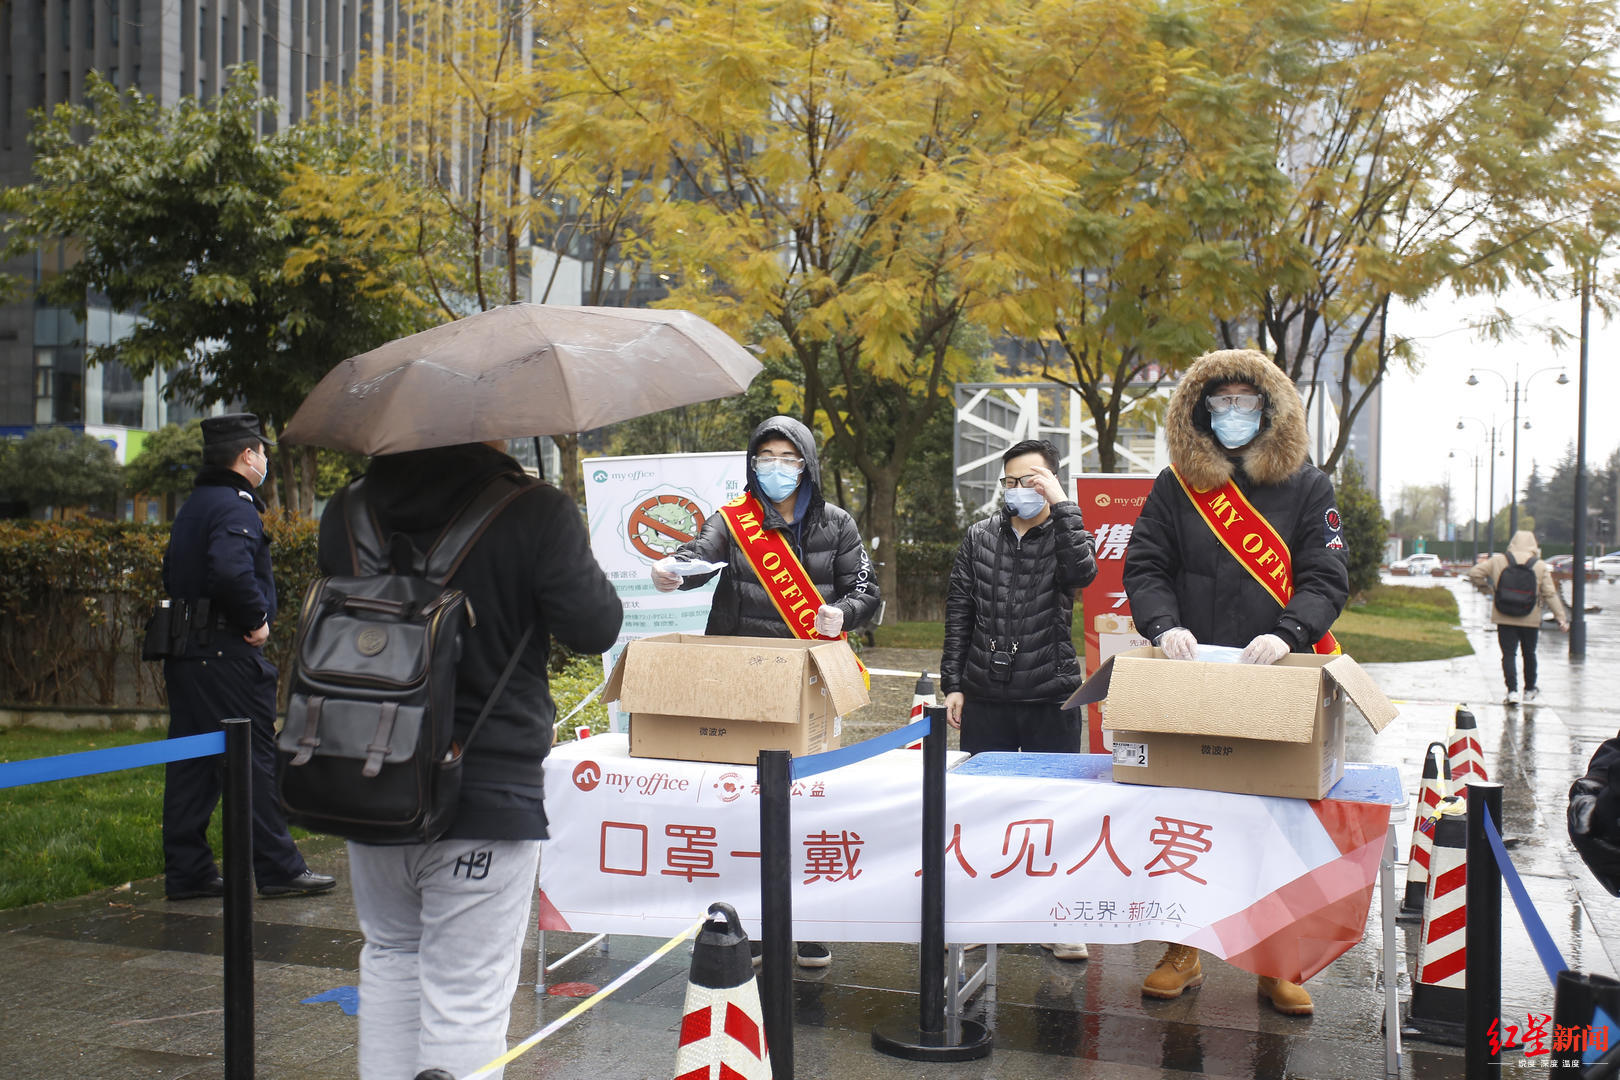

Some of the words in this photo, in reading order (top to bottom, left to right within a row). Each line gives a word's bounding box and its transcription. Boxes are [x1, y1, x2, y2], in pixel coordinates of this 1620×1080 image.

[628, 471, 655, 480] office
[1114, 498, 1129, 506] my
[736, 511, 768, 544] MY
[1208, 492, 1244, 530] MY
[1242, 533, 1294, 600] OFFI
[699, 727, 728, 737] 微波炉
[1201, 743, 1233, 756] 微波炉
[1138, 755, 1146, 765] 2
[605, 773, 634, 794] my
[636, 773, 689, 796] office
